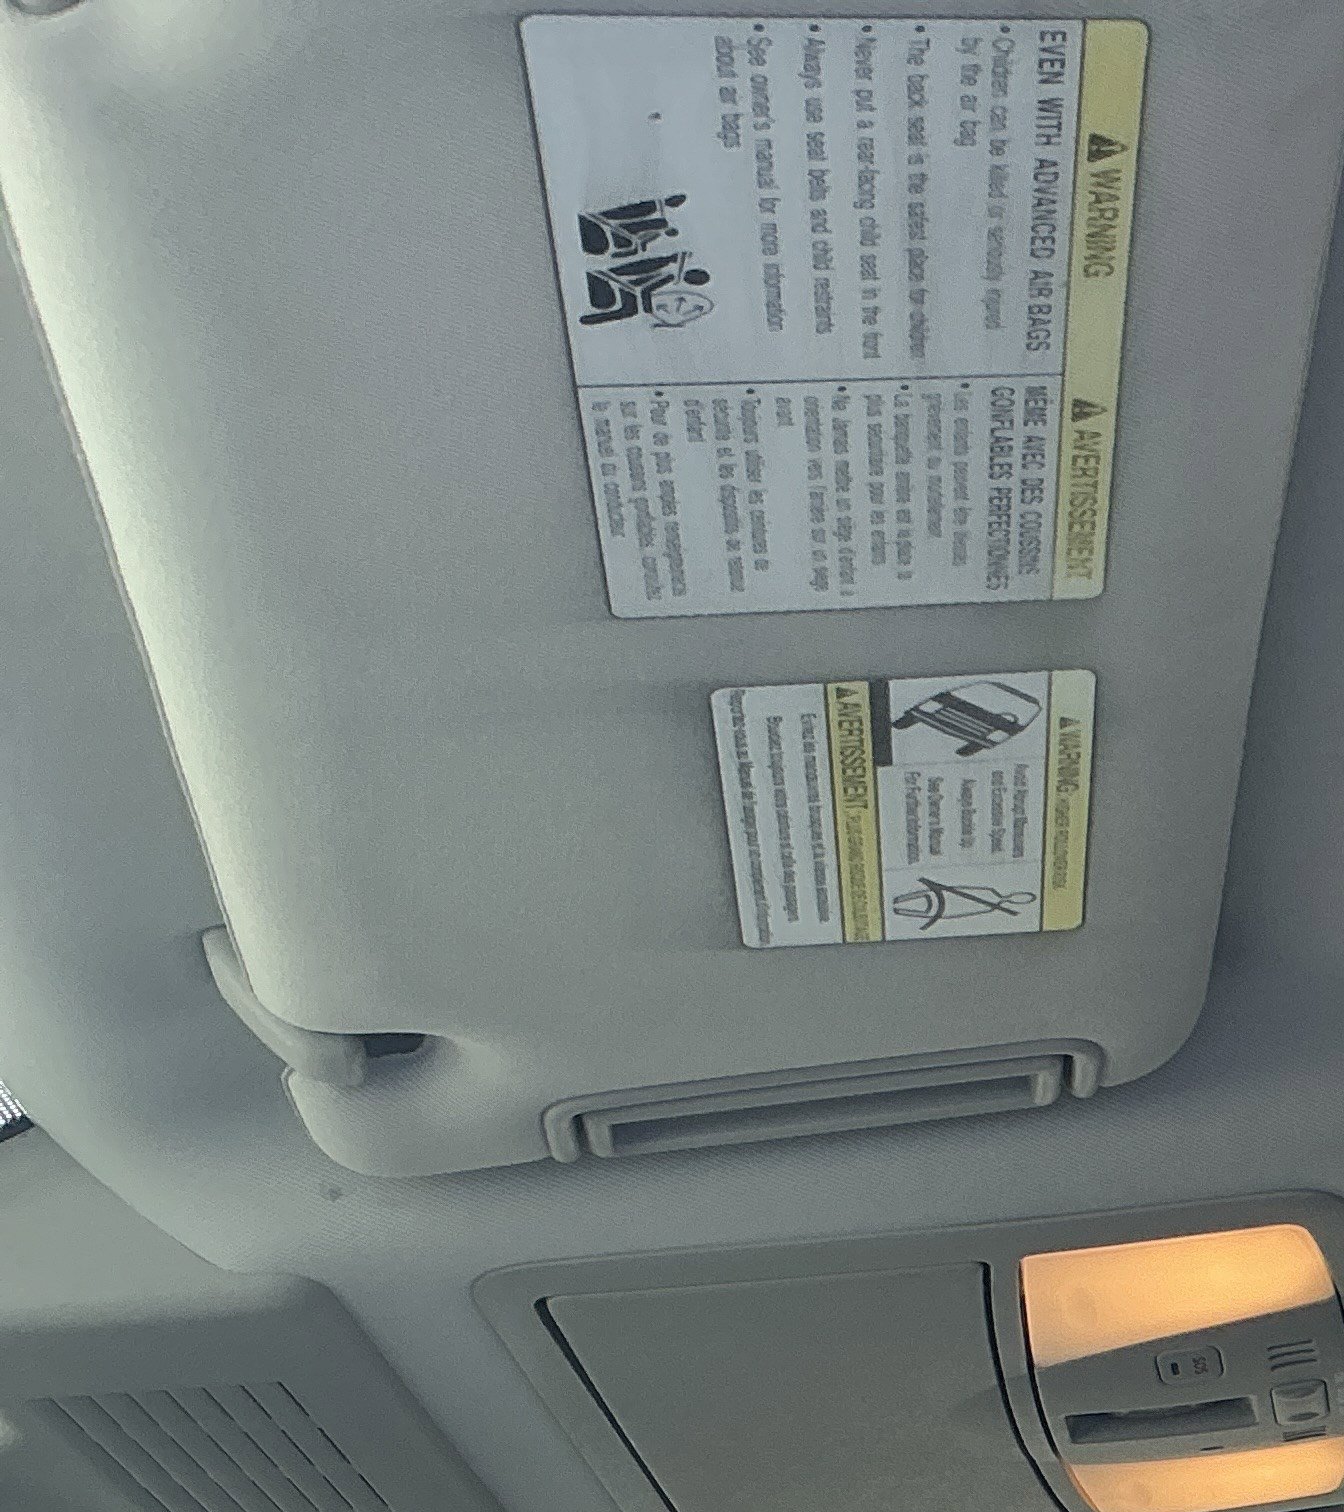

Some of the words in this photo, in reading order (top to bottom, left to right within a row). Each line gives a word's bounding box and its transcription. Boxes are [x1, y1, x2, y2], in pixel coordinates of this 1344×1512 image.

[1037, 30, 1067, 85] EVEN
[1034, 98, 1064, 147] WITH
[1029, 158, 1061, 259] ADVANCED
[1083, 168, 1122, 279] WARNING
[1020, 477, 1045, 505] DES
[1065, 430, 1102, 580] AVERTISSEMENT
